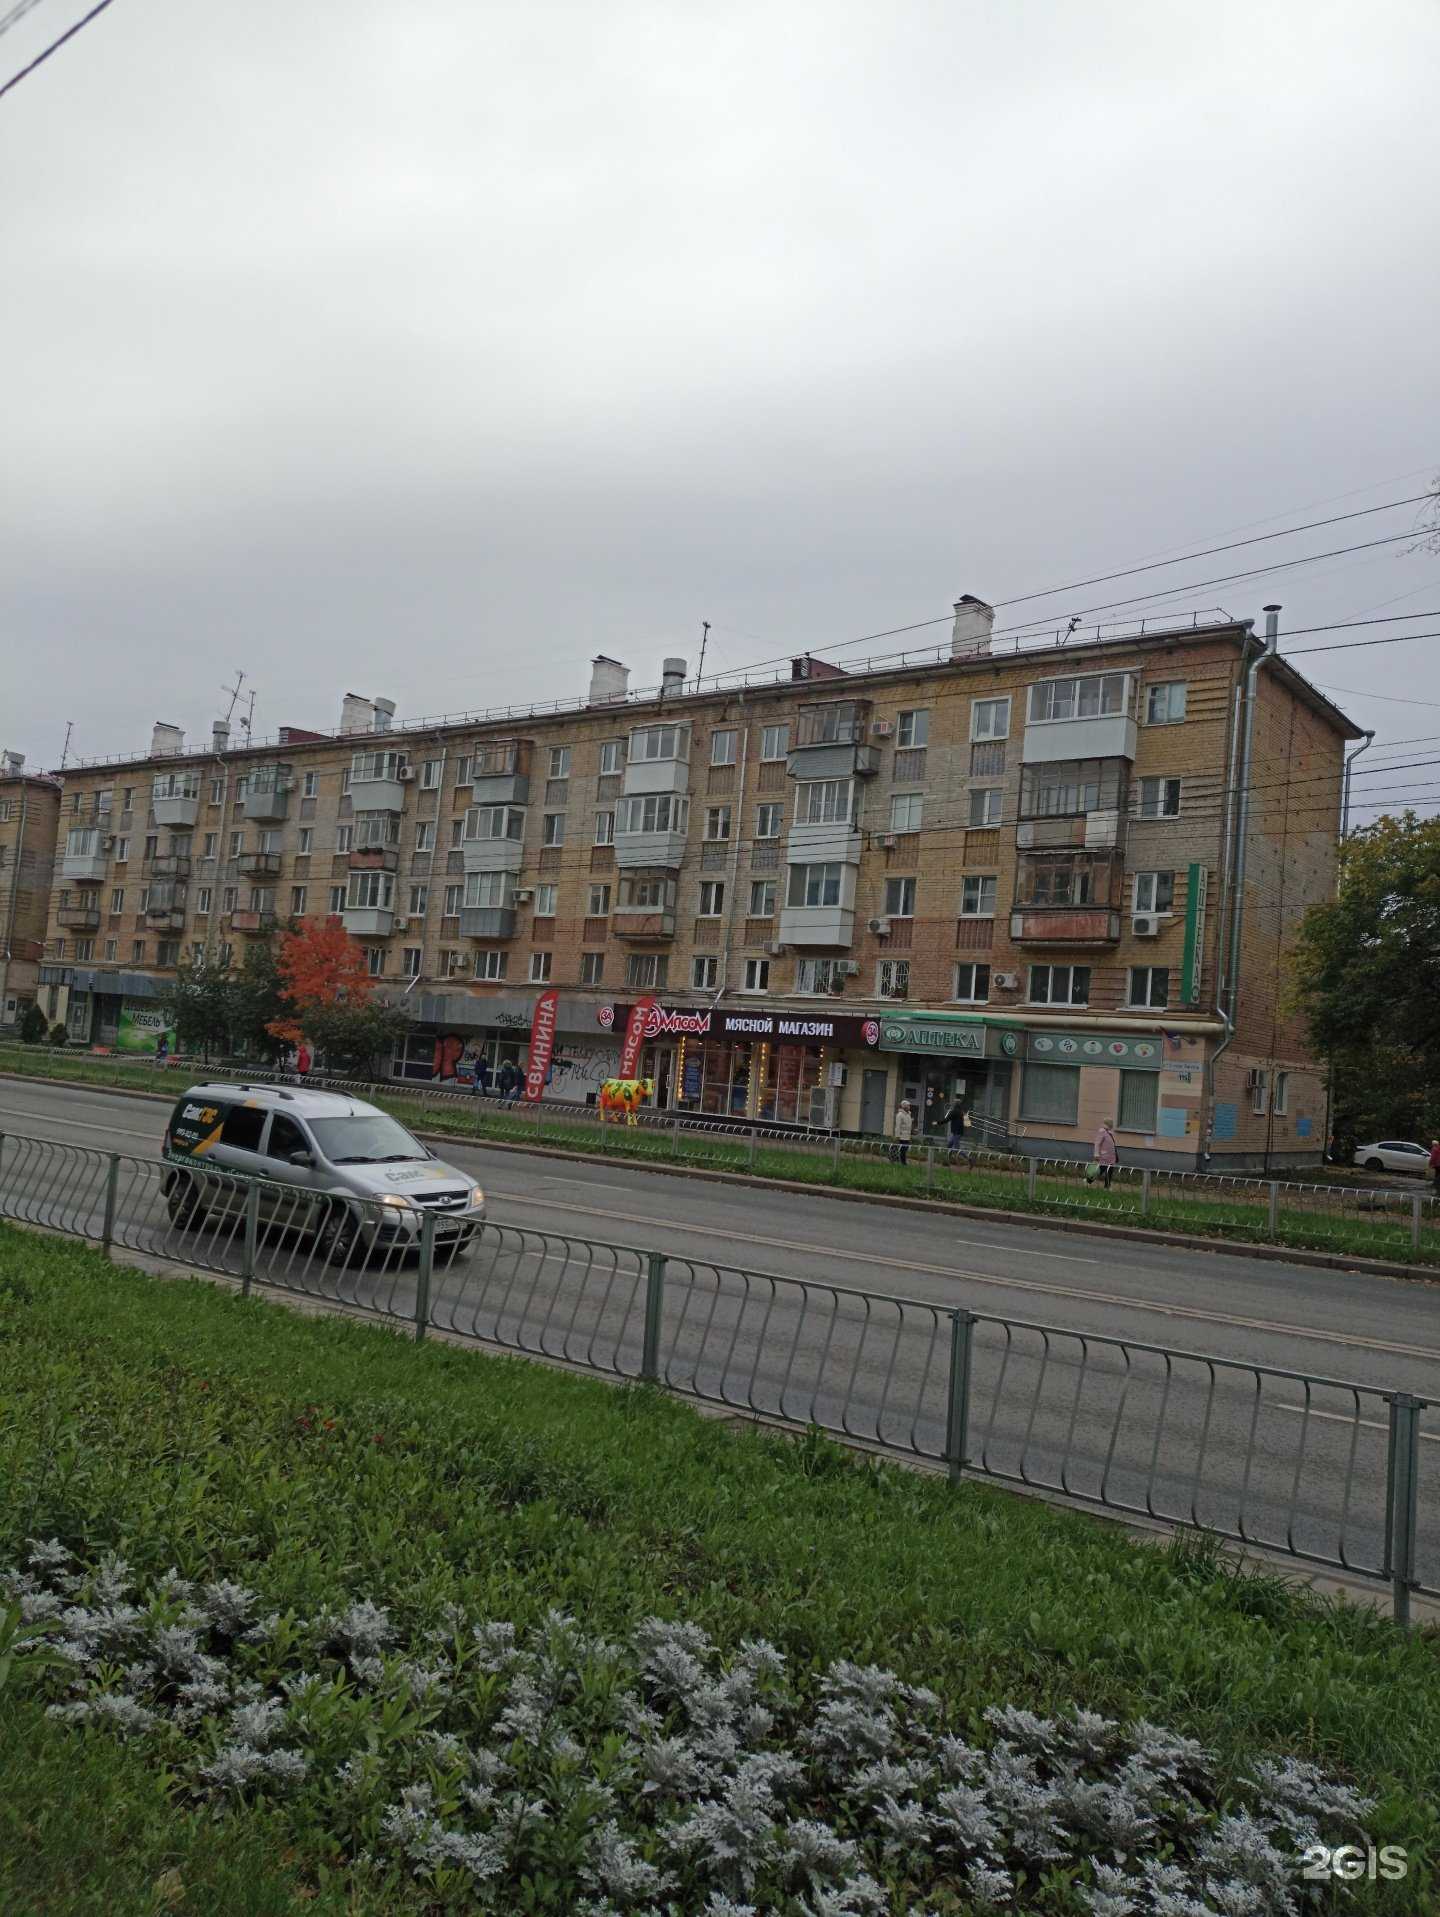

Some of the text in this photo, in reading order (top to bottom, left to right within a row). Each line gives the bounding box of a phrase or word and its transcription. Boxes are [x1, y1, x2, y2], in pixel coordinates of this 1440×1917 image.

[527, 999, 555, 1098] СВИНИНА
[622, 1007, 648, 1075] МЯСОМ
[725, 1017, 834, 1037] МЯСНОЙ МАГАЗИН
[905, 1028, 980, 1049] АПТЕКА
